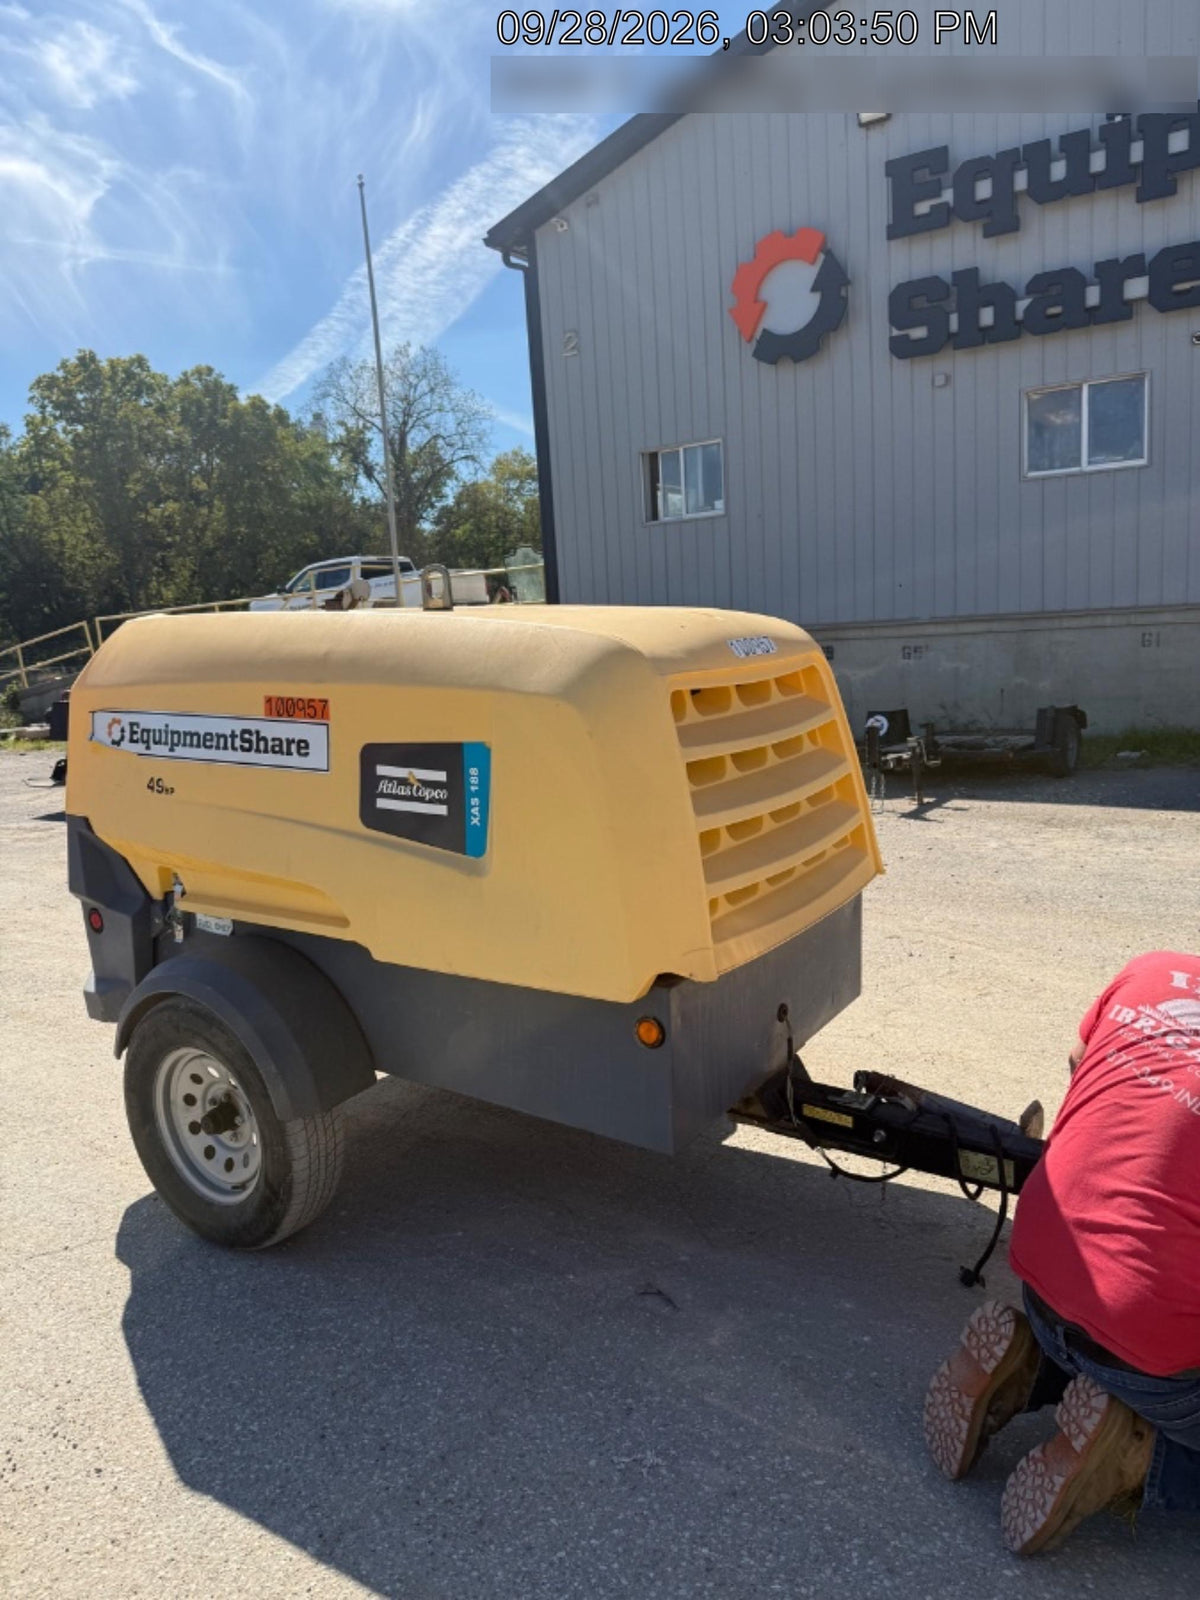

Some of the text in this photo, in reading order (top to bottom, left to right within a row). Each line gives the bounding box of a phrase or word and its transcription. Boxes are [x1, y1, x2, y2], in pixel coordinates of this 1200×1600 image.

[888, 241, 1200, 360] Share
[563, 331, 579, 357] 2
[265, 695, 329, 719] 100957
[128, 721, 310, 757] EquipmentShare
[376, 779, 448, 801] Atlas Copco
[469, 767, 480, 826] XAS 188
